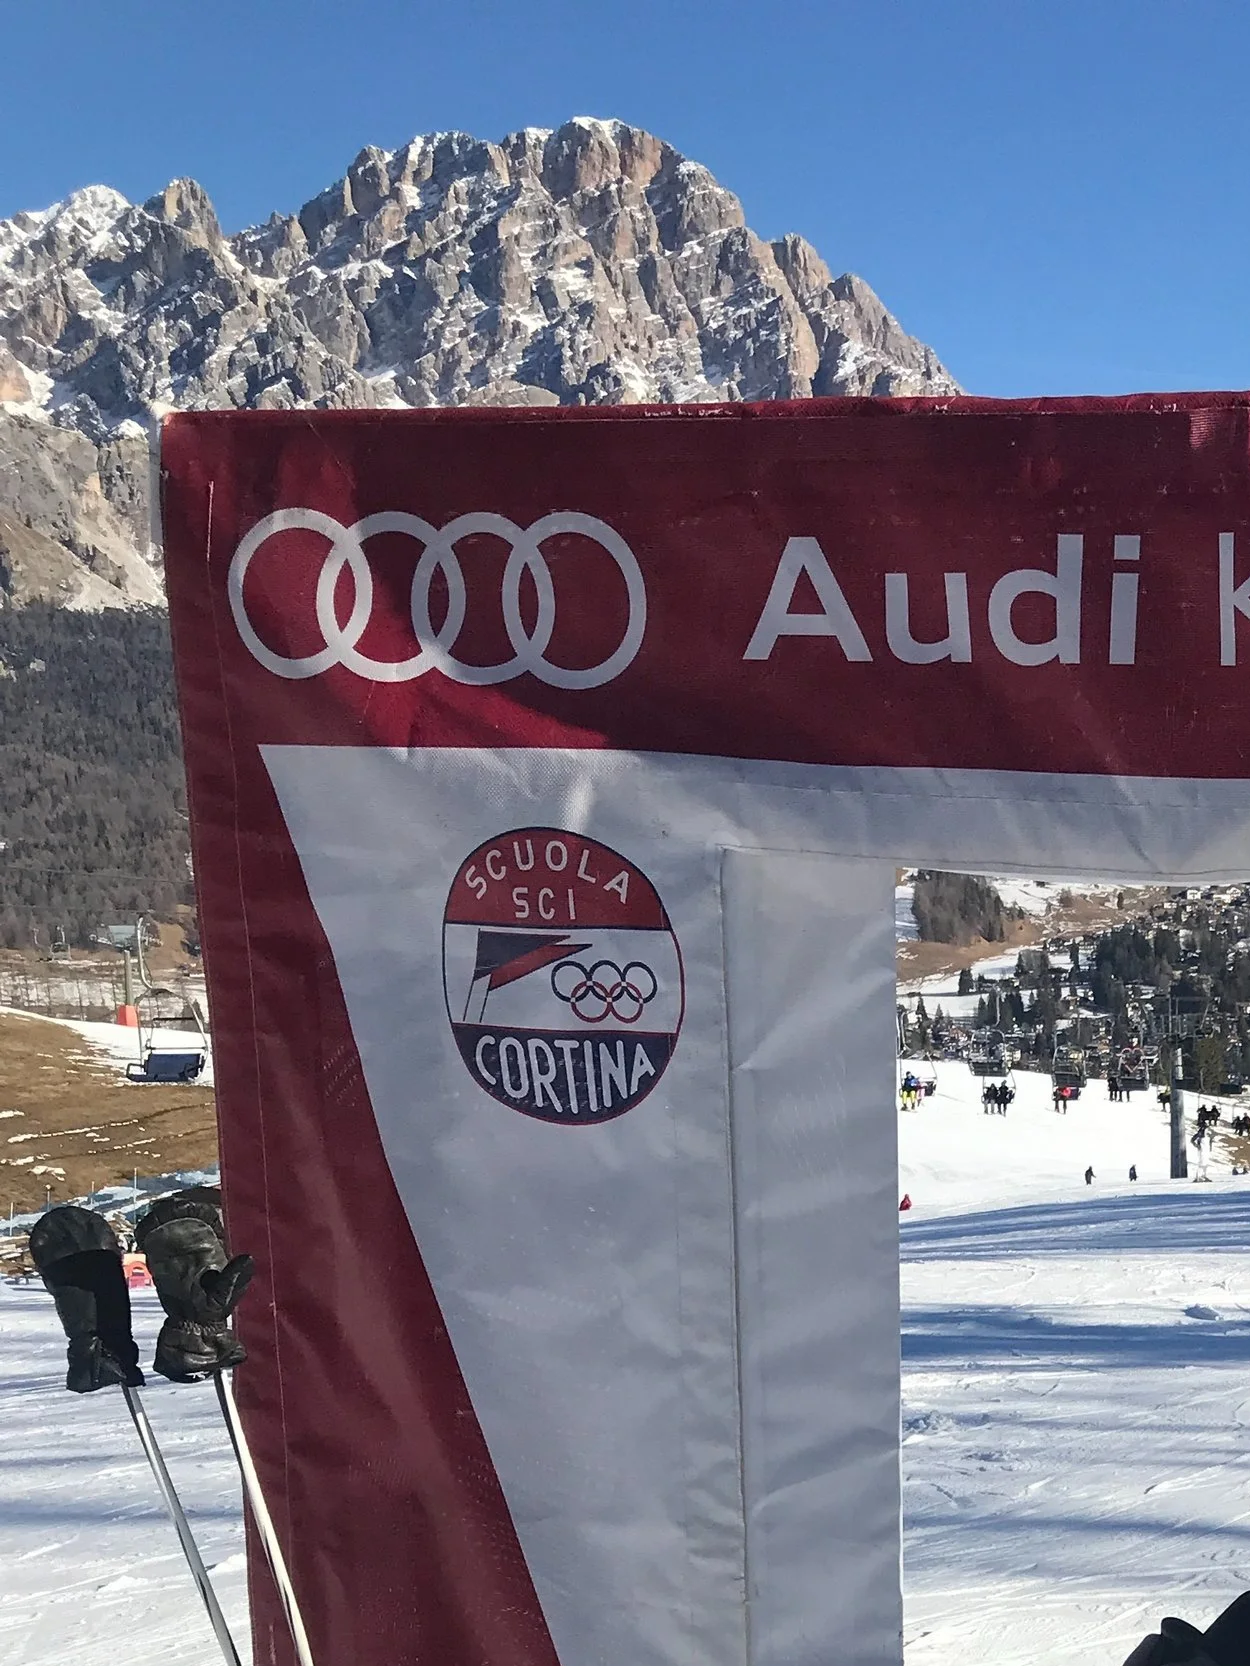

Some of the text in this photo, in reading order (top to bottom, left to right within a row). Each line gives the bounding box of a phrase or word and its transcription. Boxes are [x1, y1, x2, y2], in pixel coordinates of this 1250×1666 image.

[742, 532, 1141, 665] Audi
[465, 839, 629, 905] SCUOLA
[512, 887, 576, 920] SCI
[475, 1034, 656, 1114] CORTINA
